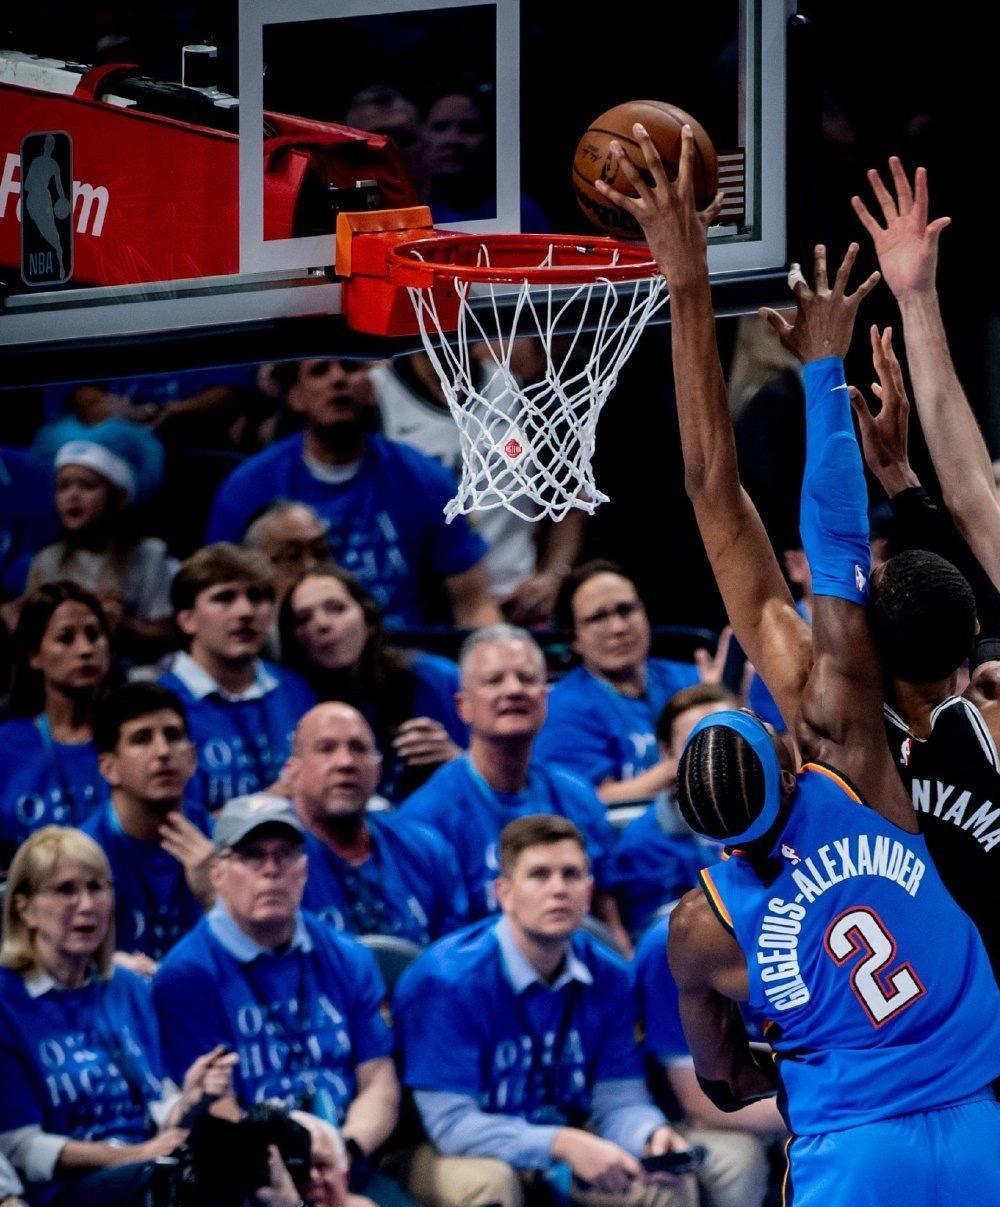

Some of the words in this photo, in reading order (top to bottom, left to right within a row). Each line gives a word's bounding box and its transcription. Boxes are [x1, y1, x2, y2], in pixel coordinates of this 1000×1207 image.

[0, 152, 110, 237] Fm
[29, 252, 53, 276] NBA
[757, 834, 926, 1011] GILGEOUS-ALEXANDER
[825, 905, 928, 1030] 2
